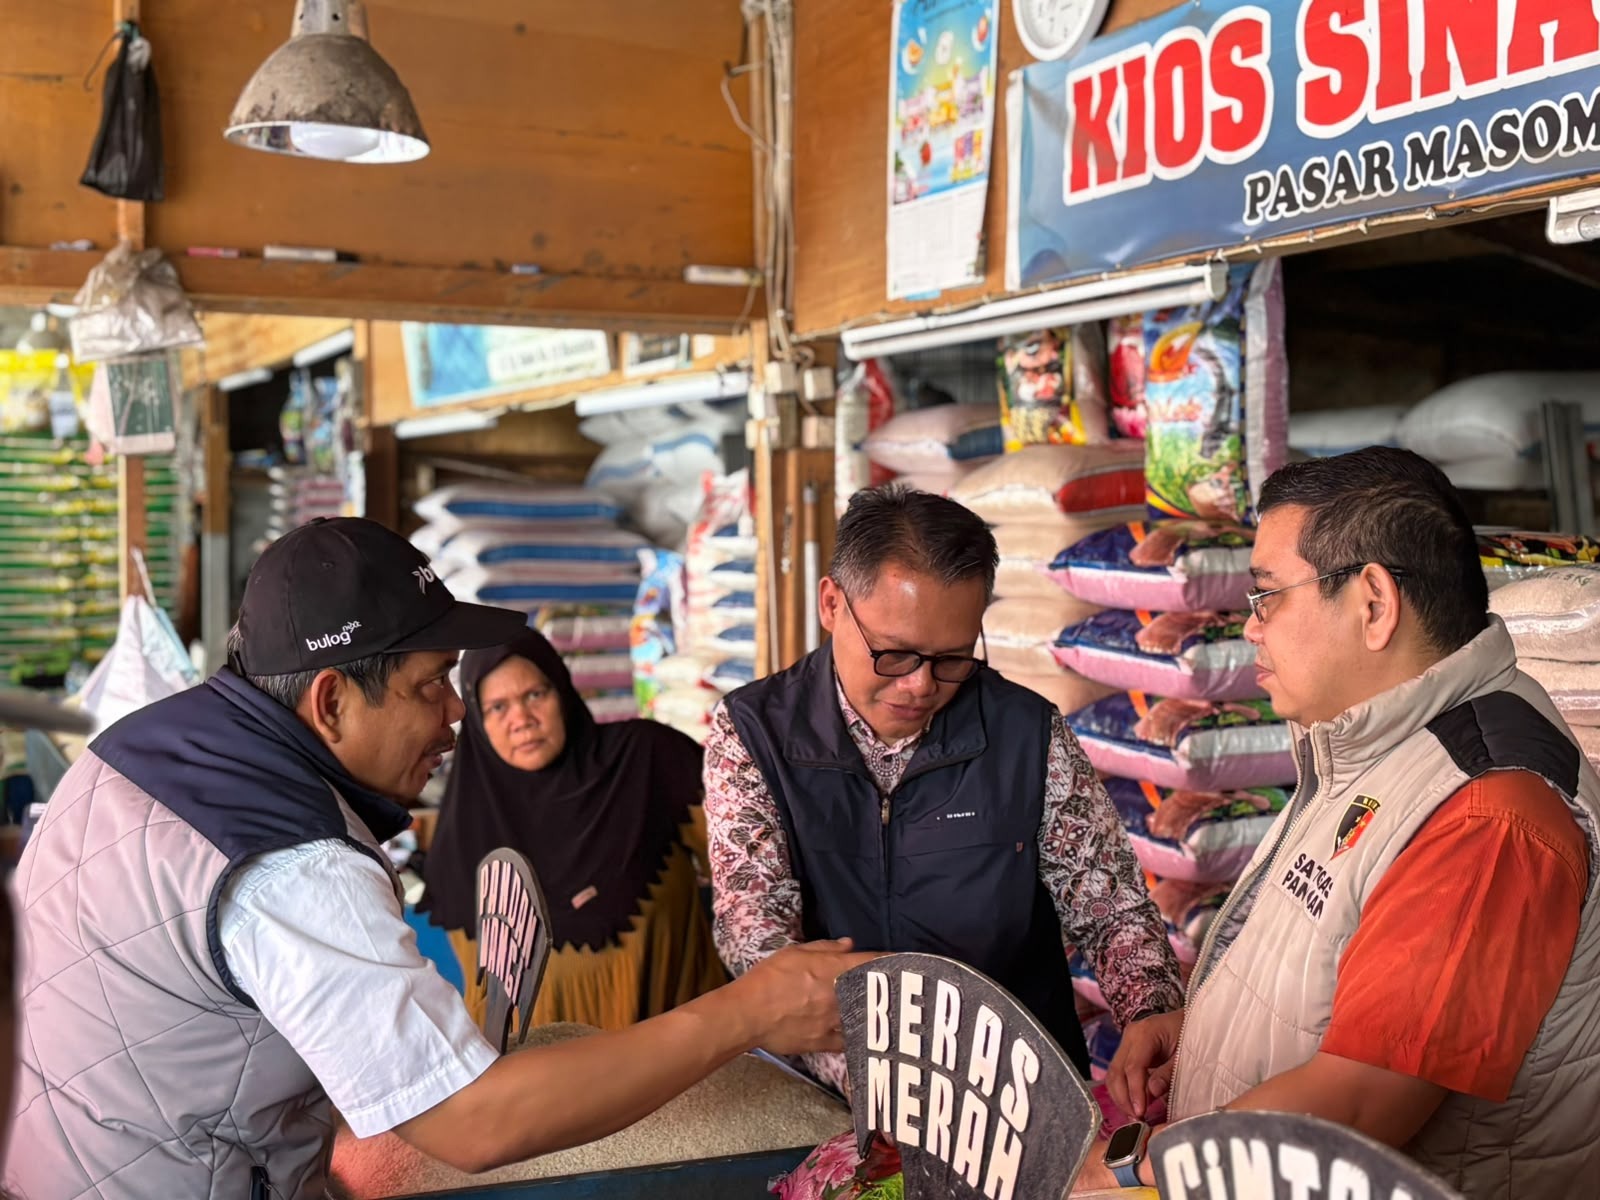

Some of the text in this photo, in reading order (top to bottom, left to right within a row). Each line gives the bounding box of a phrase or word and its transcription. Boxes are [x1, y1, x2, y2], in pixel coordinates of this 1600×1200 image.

[1066, 12, 1270, 200] KIOS
[1245, 98, 1600, 222] PASAR MASOM
[306, 631, 352, 651] bulog
[479, 859, 538, 970] PANDAN
[479, 916, 526, 1006] WANGI
[867, 970, 1040, 1133] BERAS
[867, 1057, 1023, 1200] MERAH
